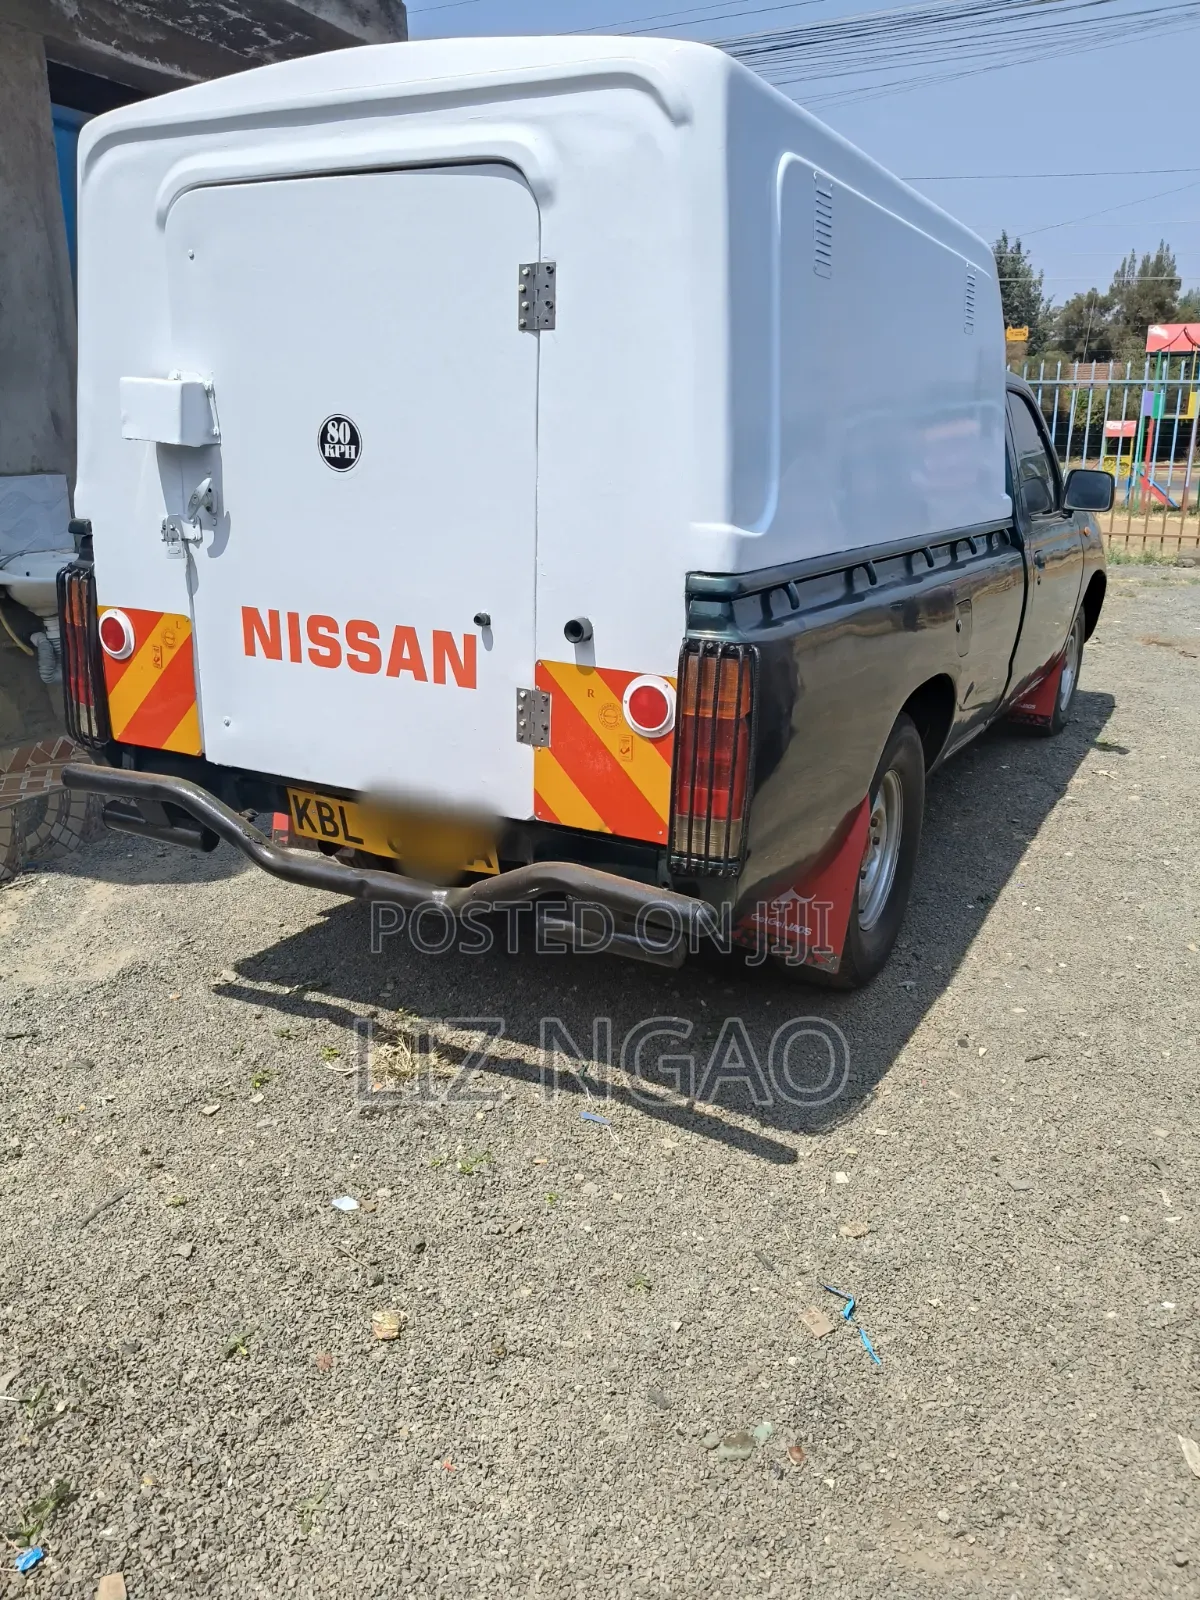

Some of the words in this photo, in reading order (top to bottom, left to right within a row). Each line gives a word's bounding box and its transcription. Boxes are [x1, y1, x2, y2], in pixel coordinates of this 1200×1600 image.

[327, 421, 351, 445] 80
[324, 443, 357, 459] KPH
[241, 605, 477, 690] NISSAN
[587, 688, 595, 698] R
[292, 794, 364, 845] KBL
